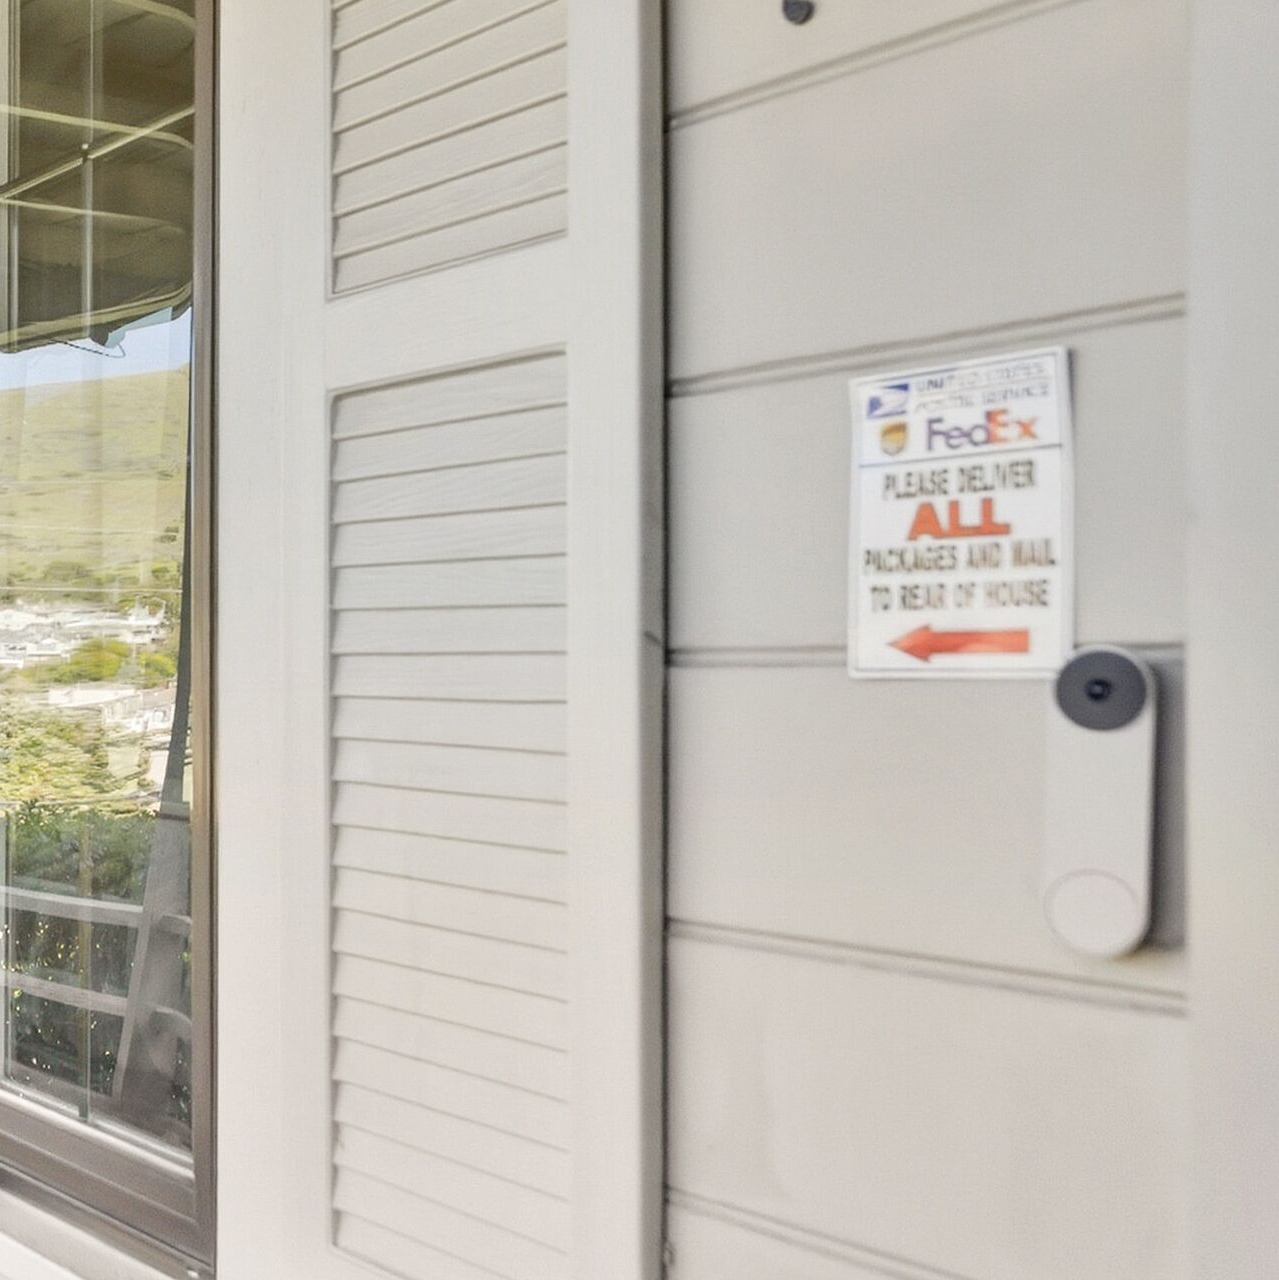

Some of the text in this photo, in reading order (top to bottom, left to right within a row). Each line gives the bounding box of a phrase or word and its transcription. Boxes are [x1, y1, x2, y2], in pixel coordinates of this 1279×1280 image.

[926, 408, 1039, 451] FedEx
[883, 460, 1035, 500] PLEASE DELIVER
[907, 497, 1011, 541] ALL
[864, 545, 958, 575] PACKAGES
[967, 542, 1001, 568] AND
[870, 578, 1050, 612] TO REAR OF HOUSE
